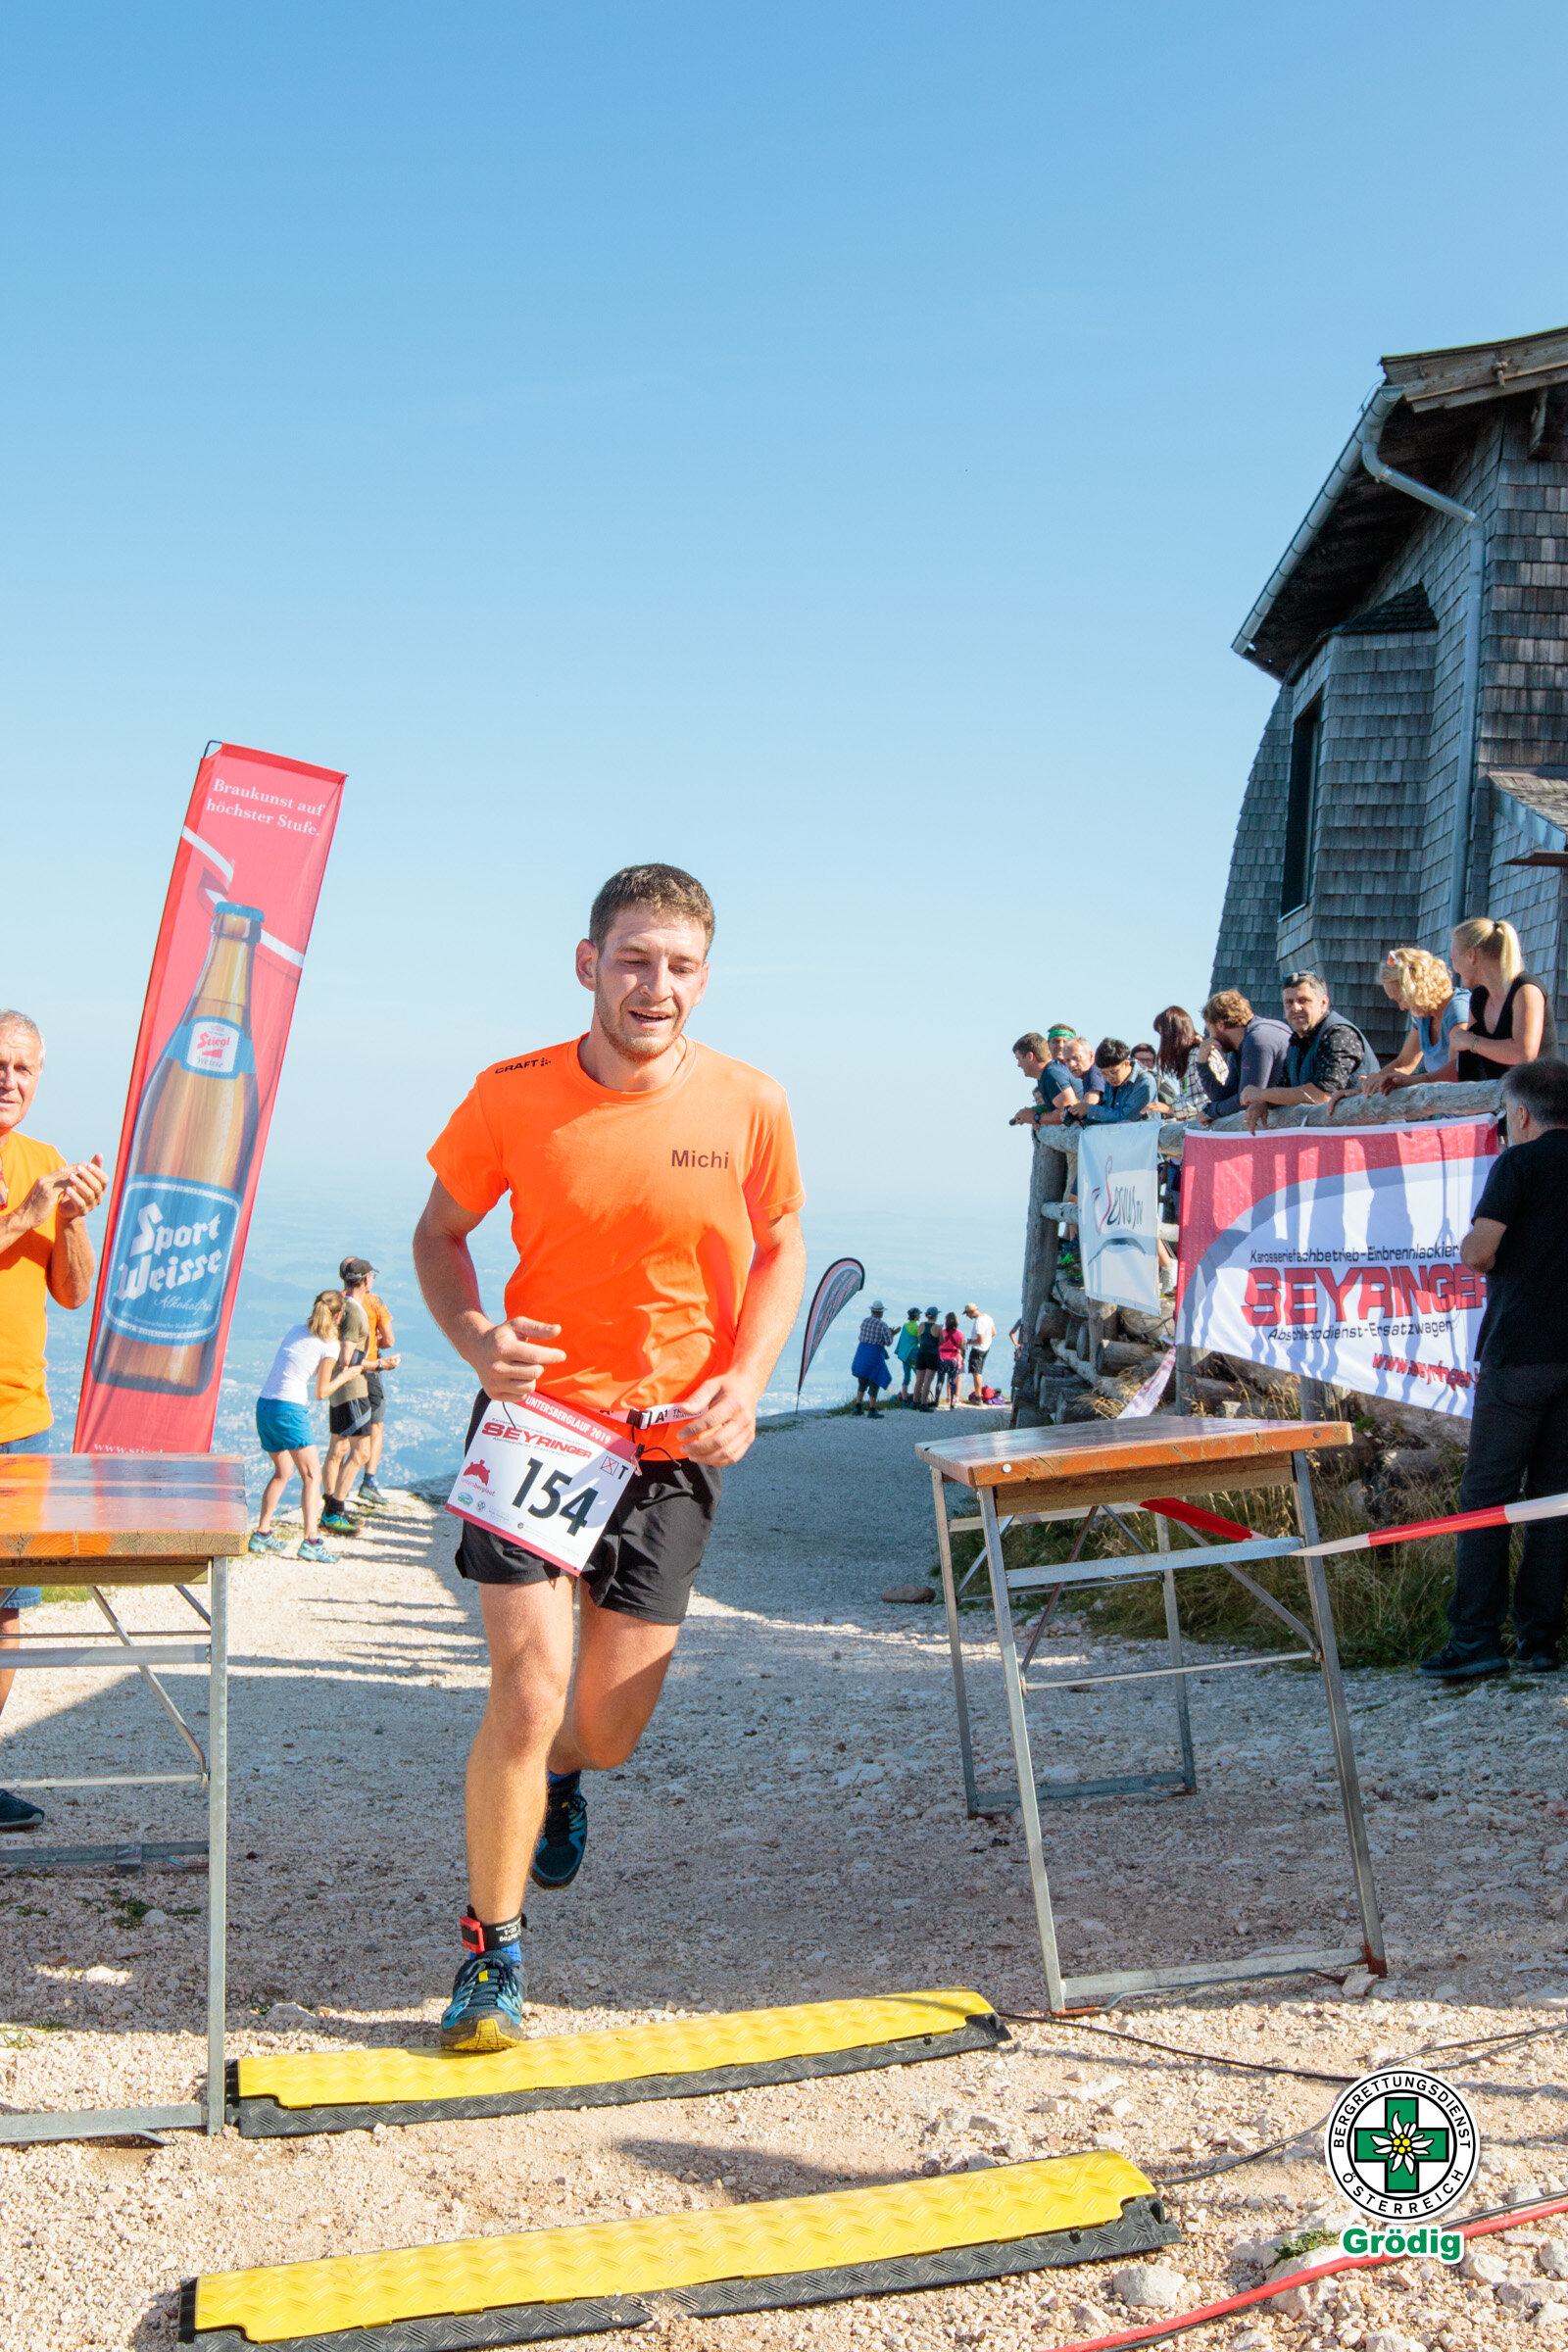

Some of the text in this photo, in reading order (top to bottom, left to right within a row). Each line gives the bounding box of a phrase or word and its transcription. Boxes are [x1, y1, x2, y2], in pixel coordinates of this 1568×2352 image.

[213, 778, 326, 816] Braukunst auf
[206, 799, 320, 837] höchster Stufe.
[197, 1032, 230, 1050] Stiegl
[495, 1059, 539, 1074] CRAFT
[671, 1150, 729, 1169] Michi
[129, 1201, 220, 1257] Sport
[1250, 1241, 1459, 1264] Karosseriefachbetrieb-Einbrennlackier
[114, 1249, 221, 1301] Weisse
[1268, 1319, 1454, 1344] Abschleppdienst-Ersatzwagen
[1372, 1353, 1479, 1391] www.seyringer.
[525, 1395, 591, 1434] UNTERSBERGLAUF
[590, 1428, 612, 1445] 2019
[481, 1422, 592, 1458] SEYRINGER
[512, 1457, 599, 1537] 154
